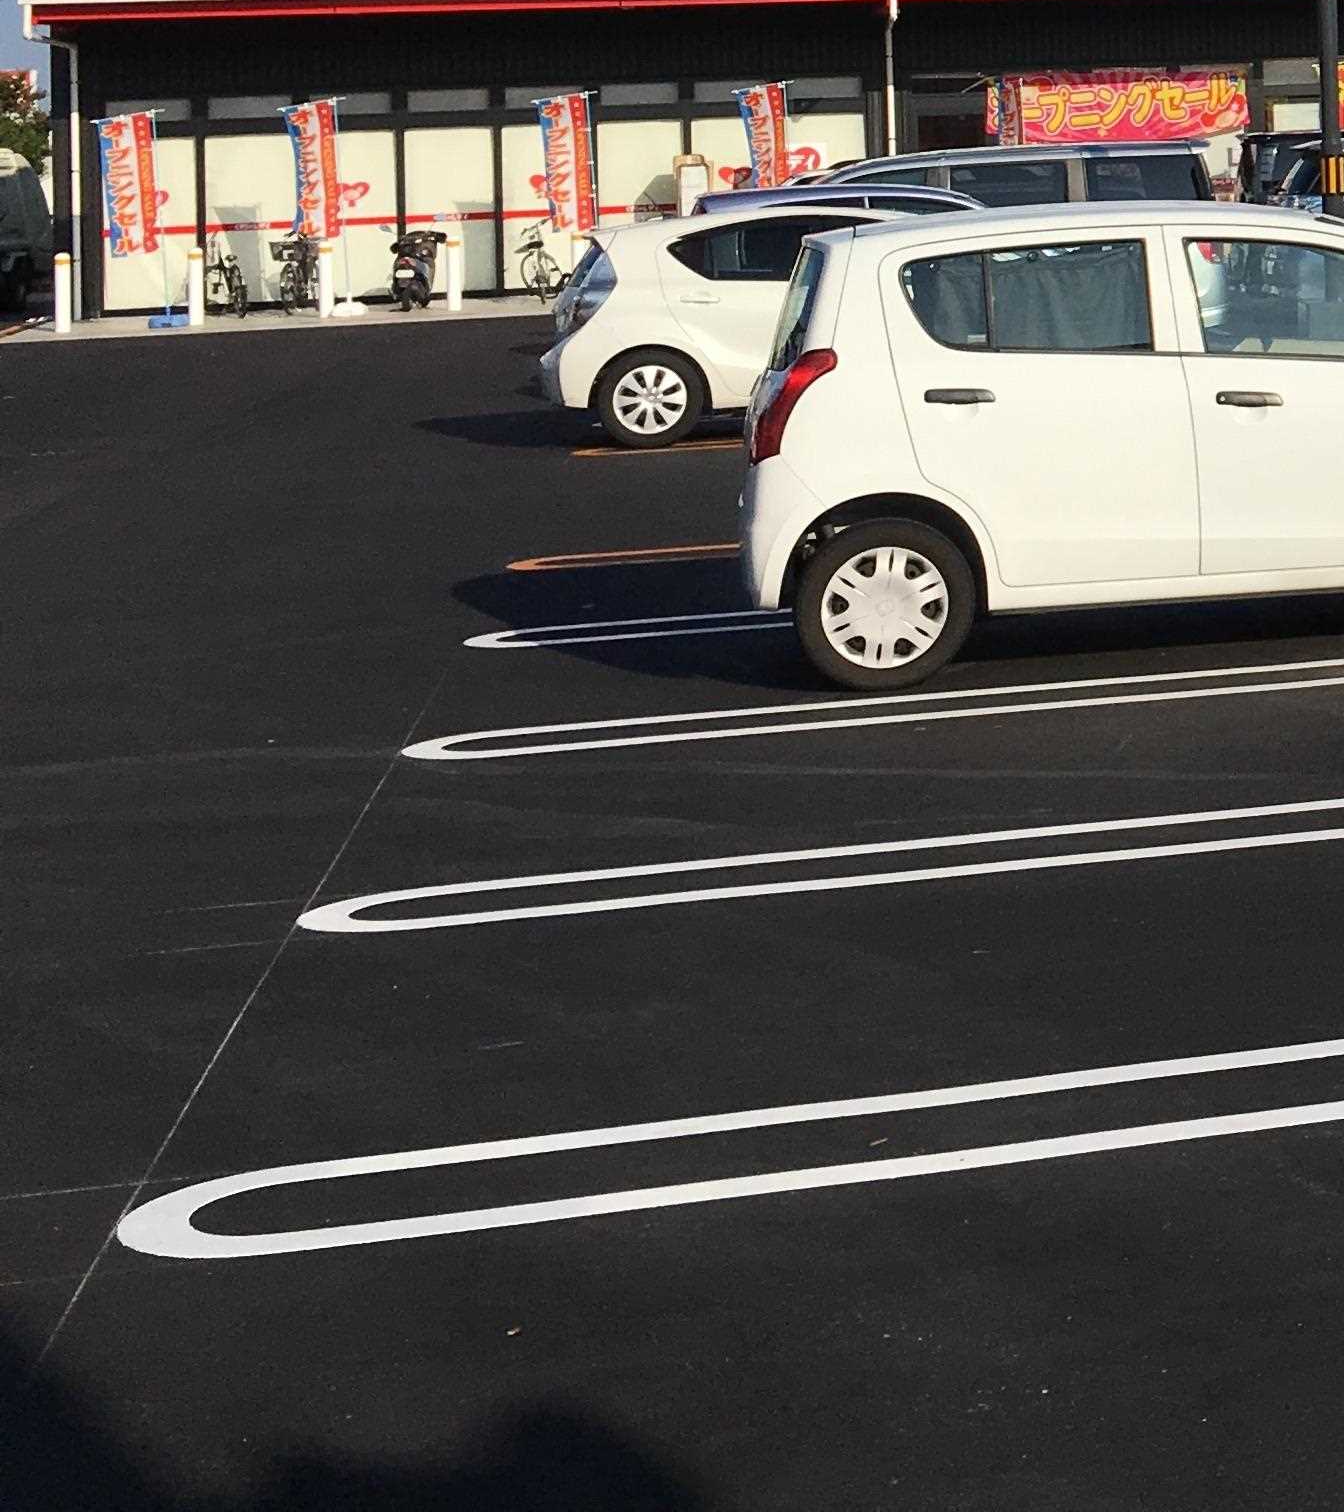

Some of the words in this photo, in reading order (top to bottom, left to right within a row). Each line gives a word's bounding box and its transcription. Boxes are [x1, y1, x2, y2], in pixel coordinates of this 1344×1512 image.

[990, 71, 1236, 133] ープニングセール
